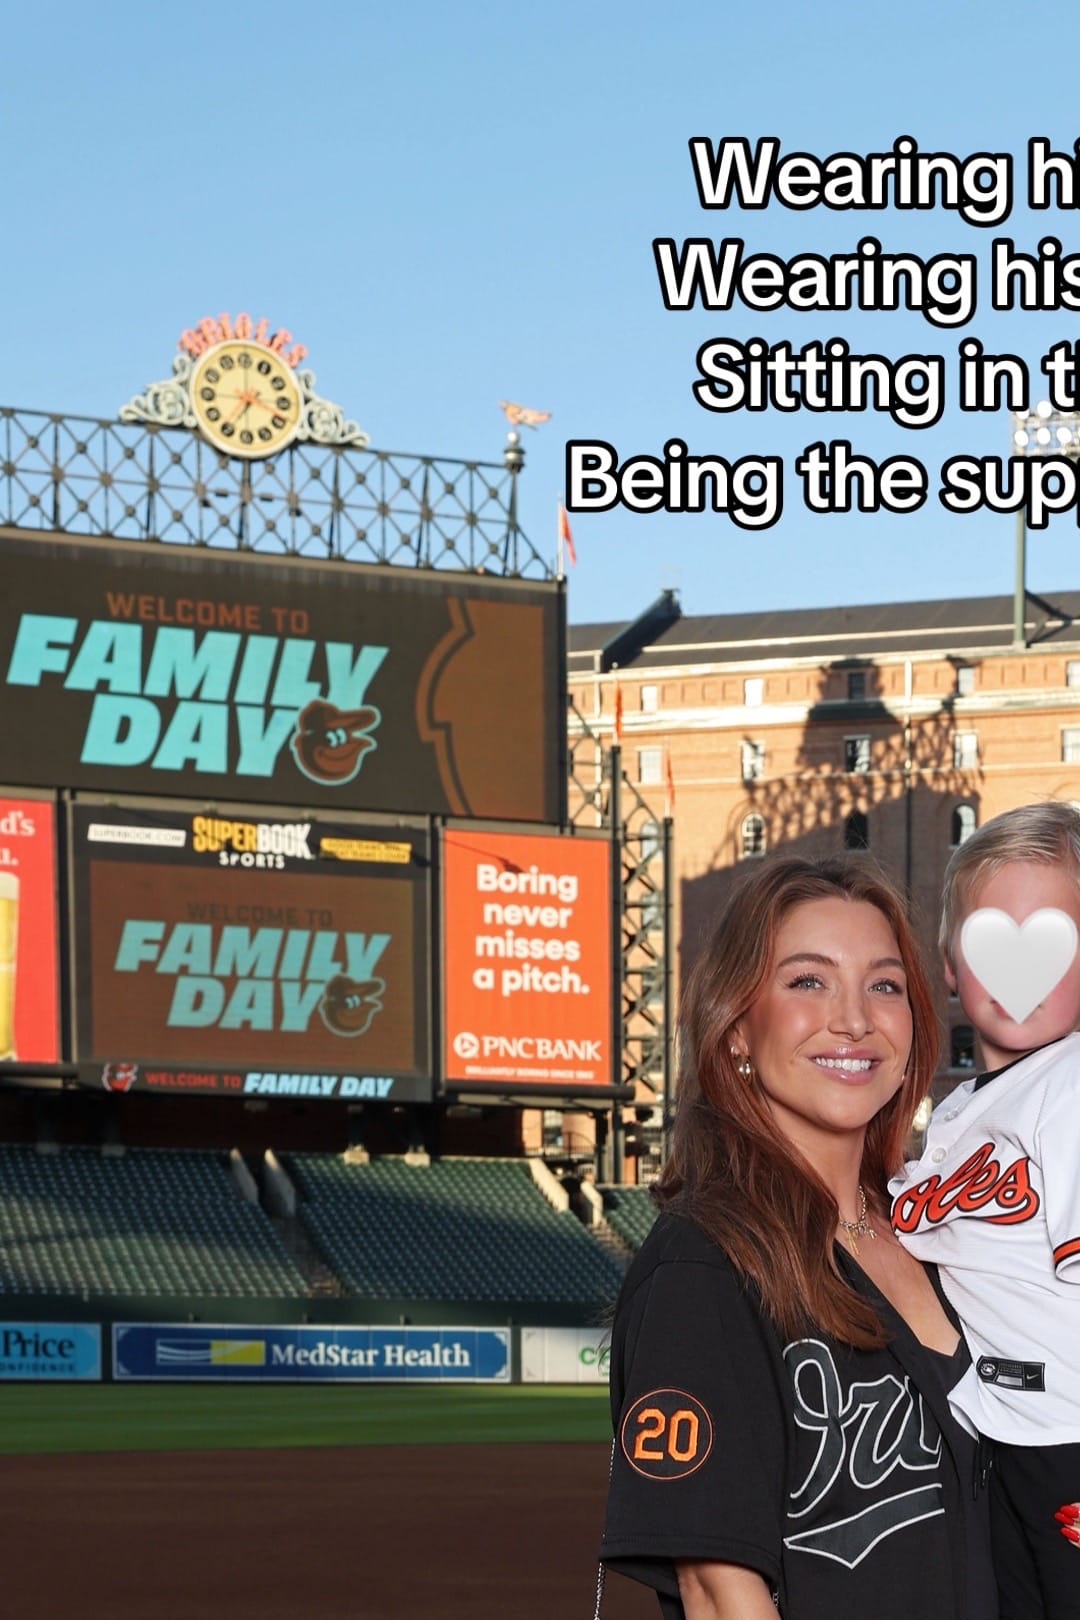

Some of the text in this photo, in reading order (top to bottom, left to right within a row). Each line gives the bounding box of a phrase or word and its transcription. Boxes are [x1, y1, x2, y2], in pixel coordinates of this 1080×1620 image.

[106, 591, 310, 635] WELCOME TO
[6, 613, 389, 708] FAMILY
[80, 693, 300, 777] DAY
[193, 816, 312, 859] SUPERBOOK
[219, 851, 285, 869] SPORTS
[476, 864, 579, 903] Boring
[188, 903, 333, 927] WELCOME TO
[483, 902, 573, 929] never
[114, 919, 392, 983] FAMILY
[475, 929, 581, 962] misses
[472, 962, 590, 997] a pitch.
[166, 975, 325, 1032] DAY
[482, 1035, 602, 1062] PNC BANK
[145, 1072, 393, 1098] WELCOME TO FAMILY DAY
[2, 1329, 76, 1360] Price
[271, 1343, 471, 1367] MedStar Health
[634, 1408, 700, 1463] 20
